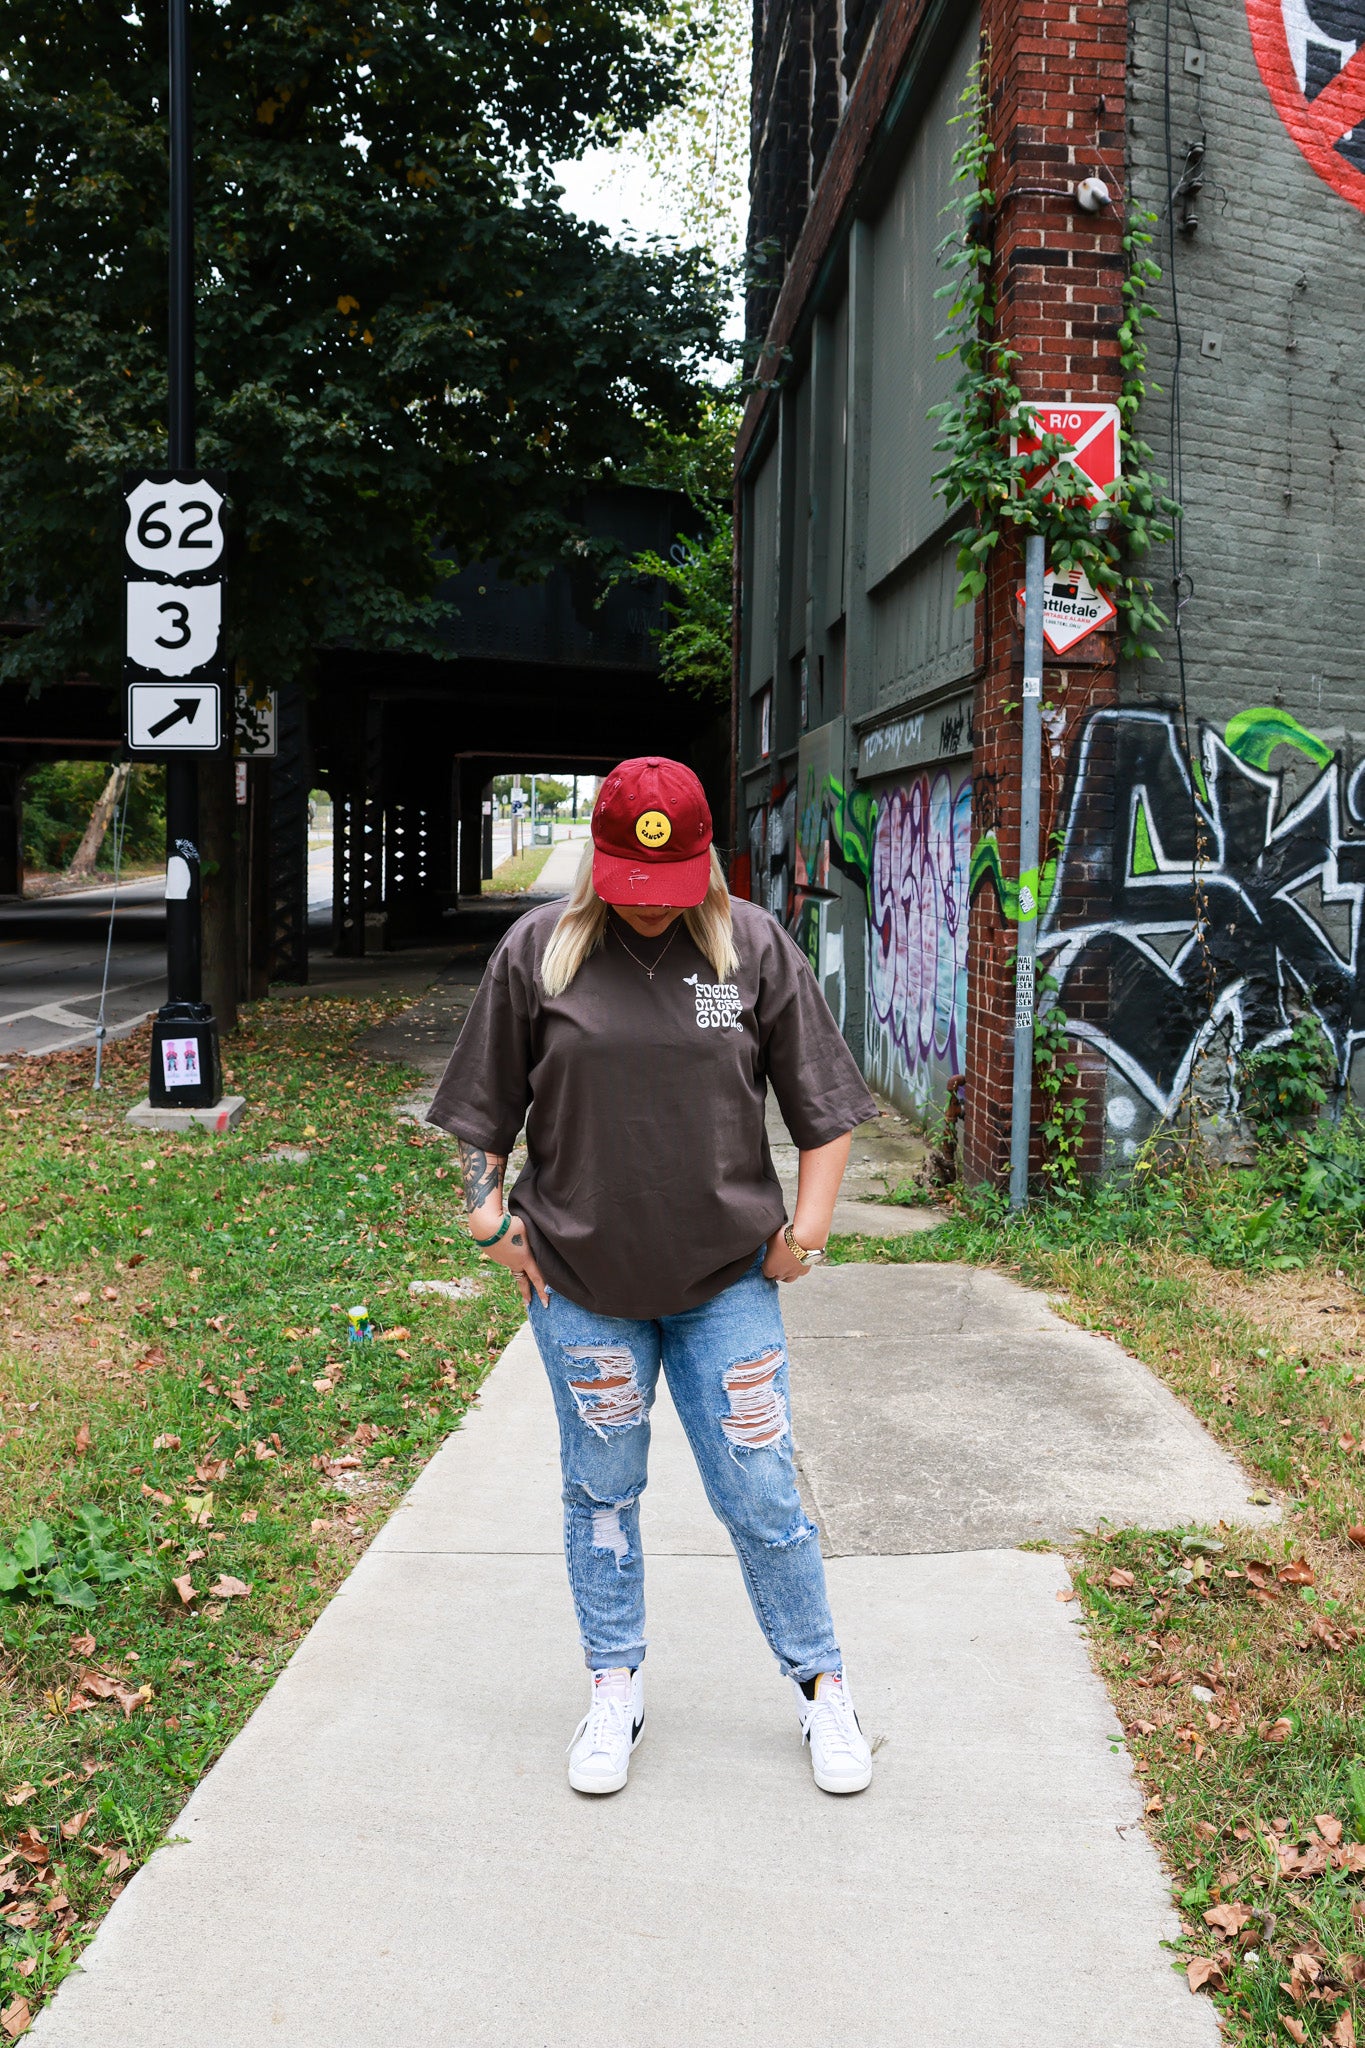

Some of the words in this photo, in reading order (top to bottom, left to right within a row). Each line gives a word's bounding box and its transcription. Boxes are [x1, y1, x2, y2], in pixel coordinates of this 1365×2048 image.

[1049, 413, 1082, 429] R/O
[137, 500, 213, 549] 62
[1043, 599, 1098, 618] attletale
[1043, 611, 1068, 620] ORTABLE
[154, 601, 191, 649] 3
[695, 983, 740, 999] FOCUS
